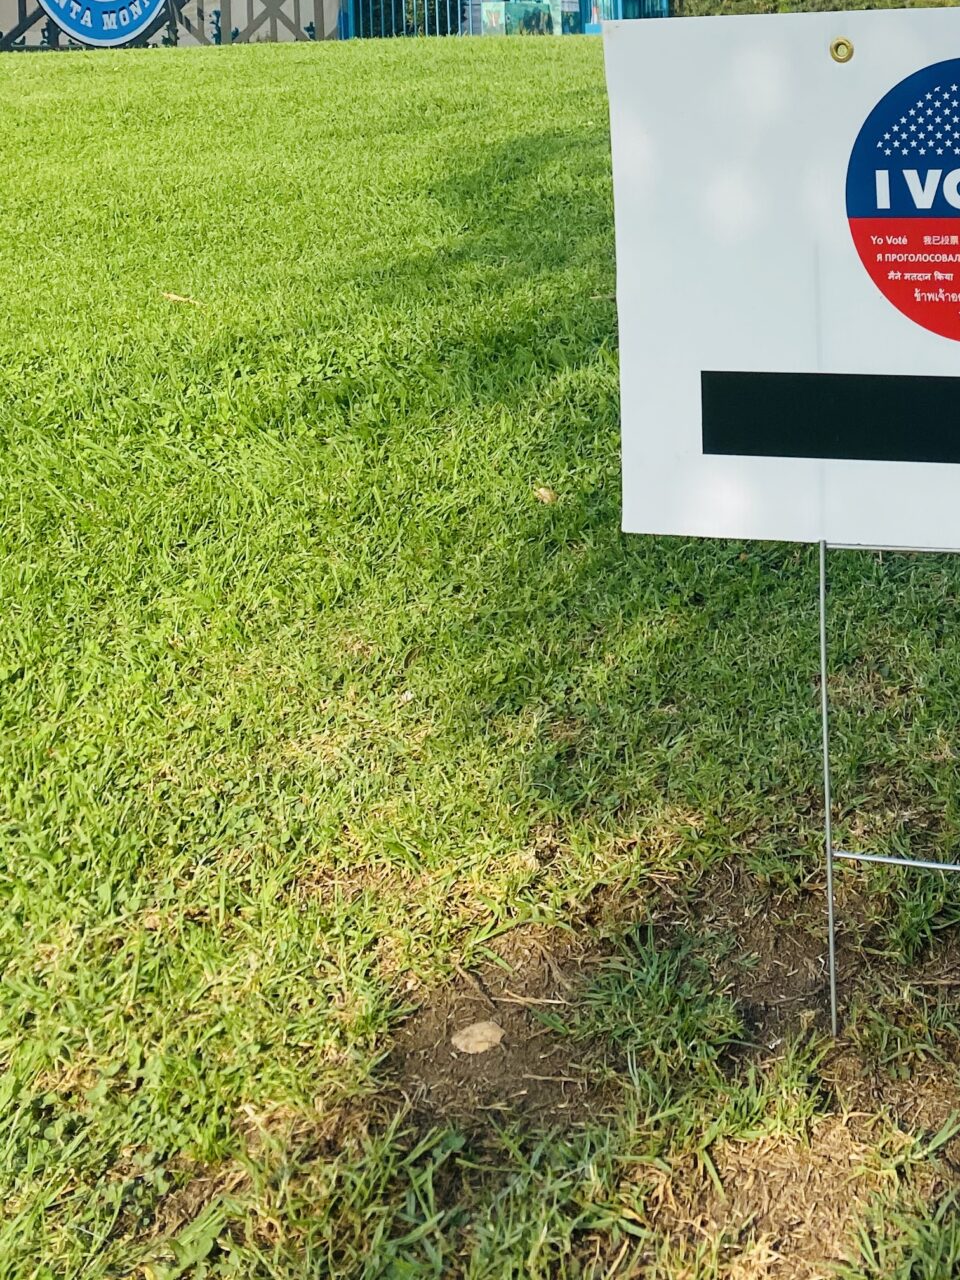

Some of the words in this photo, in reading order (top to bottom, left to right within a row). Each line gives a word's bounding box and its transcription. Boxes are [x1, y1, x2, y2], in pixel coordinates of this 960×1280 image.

[875, 169, 891, 210] I
[870, 235, 884, 245] Yo
[885, 235, 908, 245] Voté
[876, 253, 883, 262] Я
[884, 253, 960, 263] ПРОГОЛОСОВАЛ
